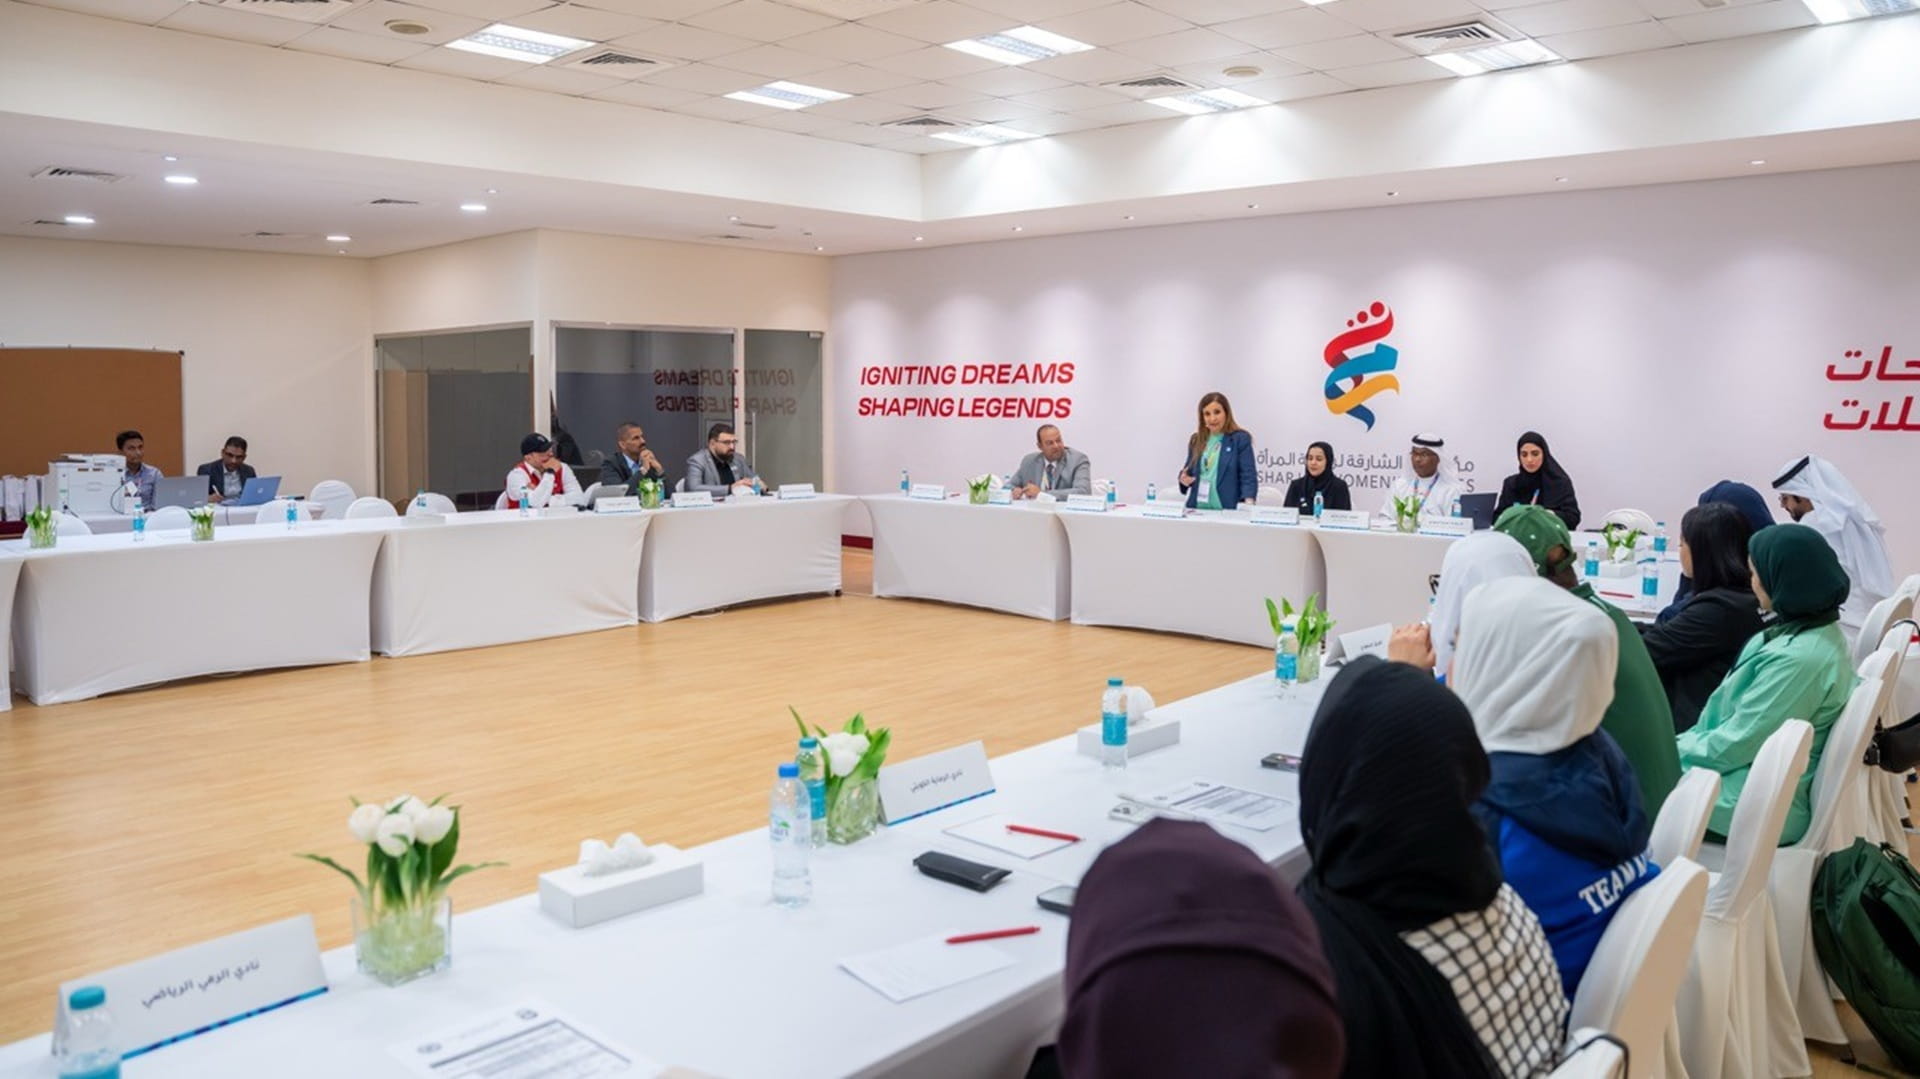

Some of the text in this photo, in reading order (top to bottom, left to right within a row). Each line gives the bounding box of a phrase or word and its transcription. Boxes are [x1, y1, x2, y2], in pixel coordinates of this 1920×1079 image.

[860, 361, 1076, 386] IGNITING DREAMS
[858, 397, 1073, 419] SHAPING LEGENDS
[1257, 447, 1296, 468] المرأة
[1347, 452, 1402, 471] الشارقة
[234, 958, 260, 980] نادي
